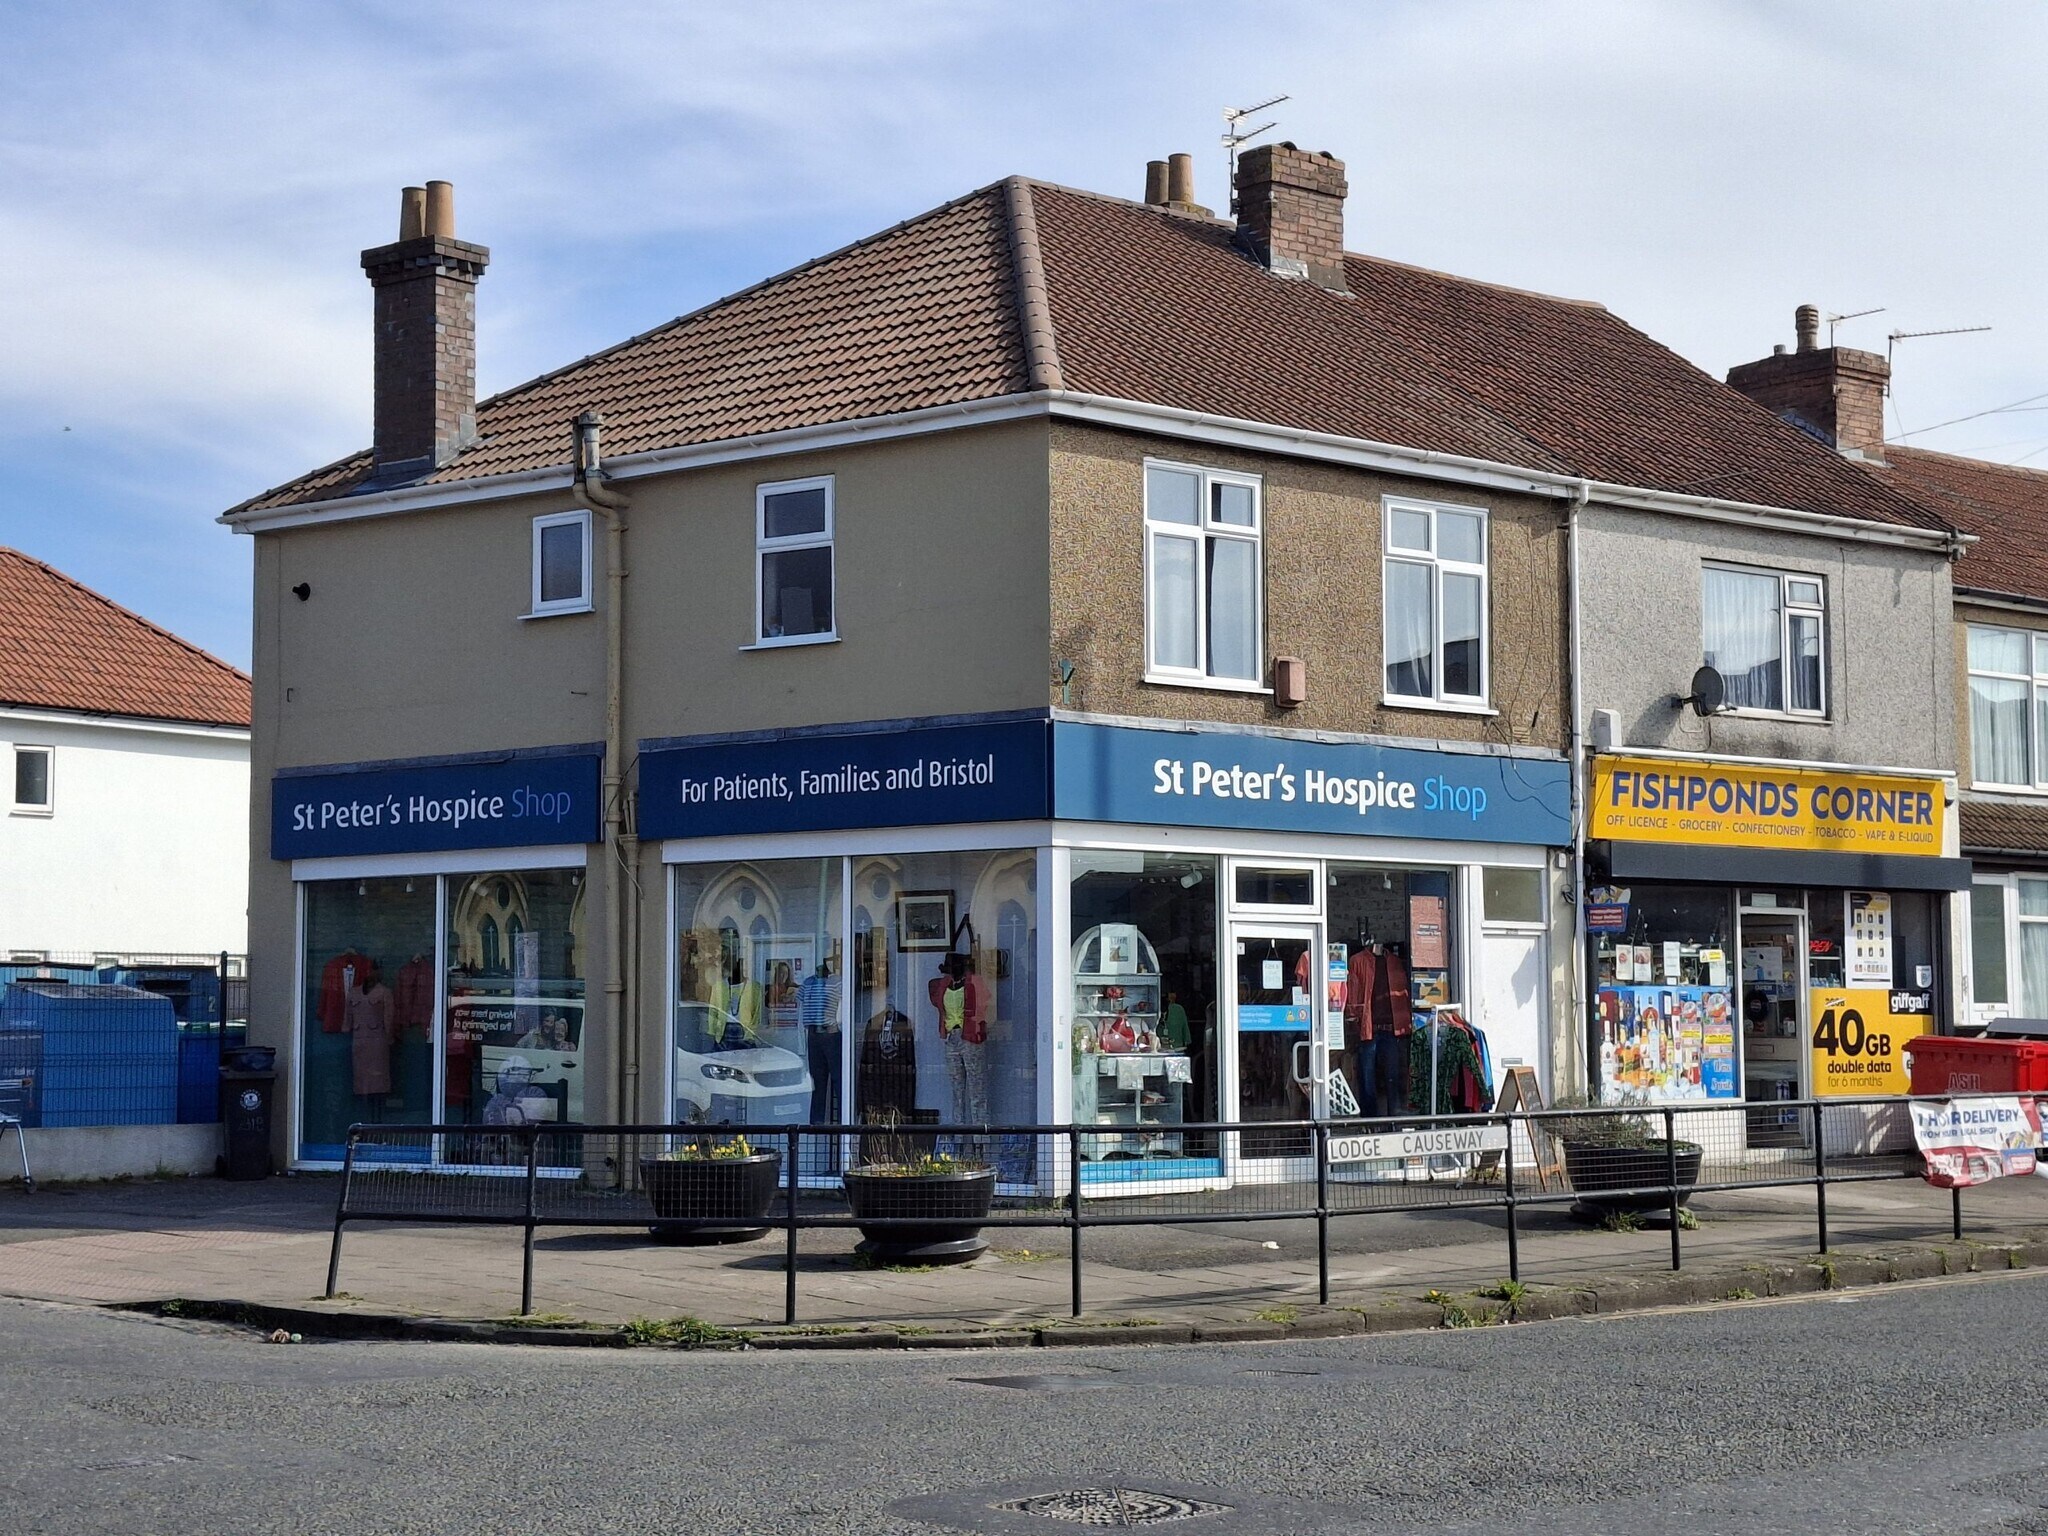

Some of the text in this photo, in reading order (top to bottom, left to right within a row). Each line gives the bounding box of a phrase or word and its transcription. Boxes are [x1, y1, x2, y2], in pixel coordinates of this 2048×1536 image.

[681, 753, 994, 804] For Patients, Families and Bristol
[1153, 758, 1487, 820] St Peter's Hospice Shop
[292, 785, 571, 831] St Peter's Hospice Shop
[1611, 770, 1934, 826] FISHPONDS CORNER
[1606, 814, 1625, 827] OFF
[1628, 815, 1668, 829] LICENCE
[1679, 818, 1723, 832] GROCERY
[1732, 822, 1806, 837] CONFECTIONERY
[1815, 826, 1856, 839] TOBACCO
[1865, 829, 1886, 841] VAPE
[1898, 831, 1934, 843] E-LIQUID
[1809, 940, 1833, 953] PEN
[1890, 992, 1931, 1013] giffgaff
[1812, 1008, 1892, 1057] 40GB
[1827, 1060, 1865, 1074] double
[1867, 1060, 1892, 1073] data
[1827, 1077, 1883, 1087] for 6 months
[1963, 1108, 2019, 1123] DELIVERY
[1330, 1130, 1485, 1160] LODGE CAUSEWAY
